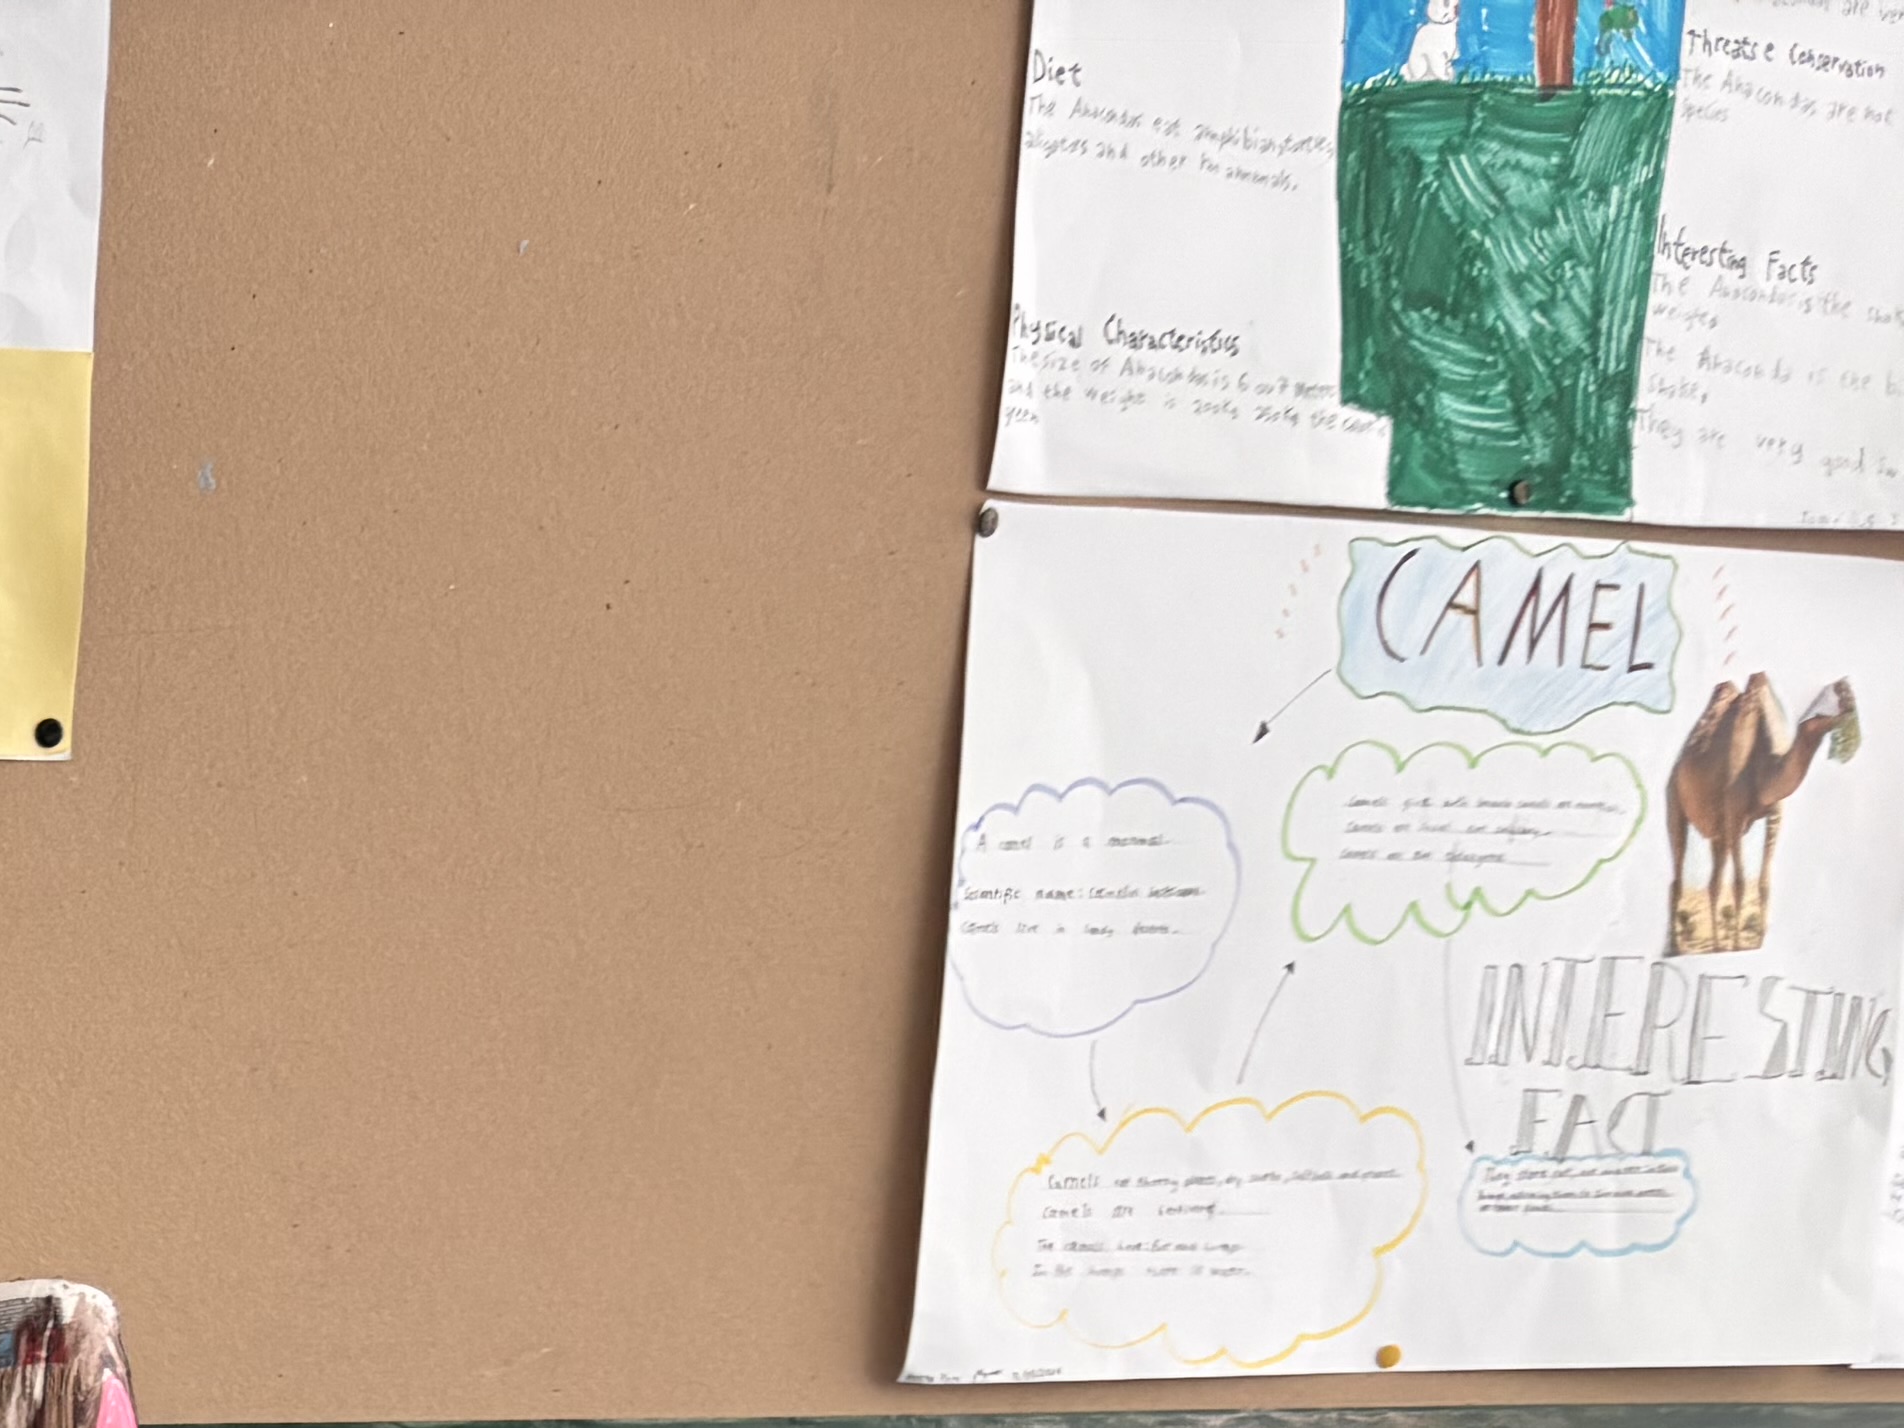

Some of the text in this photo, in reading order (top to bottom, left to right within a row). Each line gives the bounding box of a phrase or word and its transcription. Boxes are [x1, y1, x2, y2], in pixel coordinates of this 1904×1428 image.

[1032, 48, 1082, 87] Diet
[1030, 96, 1056, 117] The
[1652, 272, 1689, 297] The
[1658, 213, 1818, 285] Interesting Facts
[1375, 547, 1654, 673] CAMEL
[1464, 955, 1892, 1087] INTERESTING
[1510, 1088, 1672, 1161] FACT
